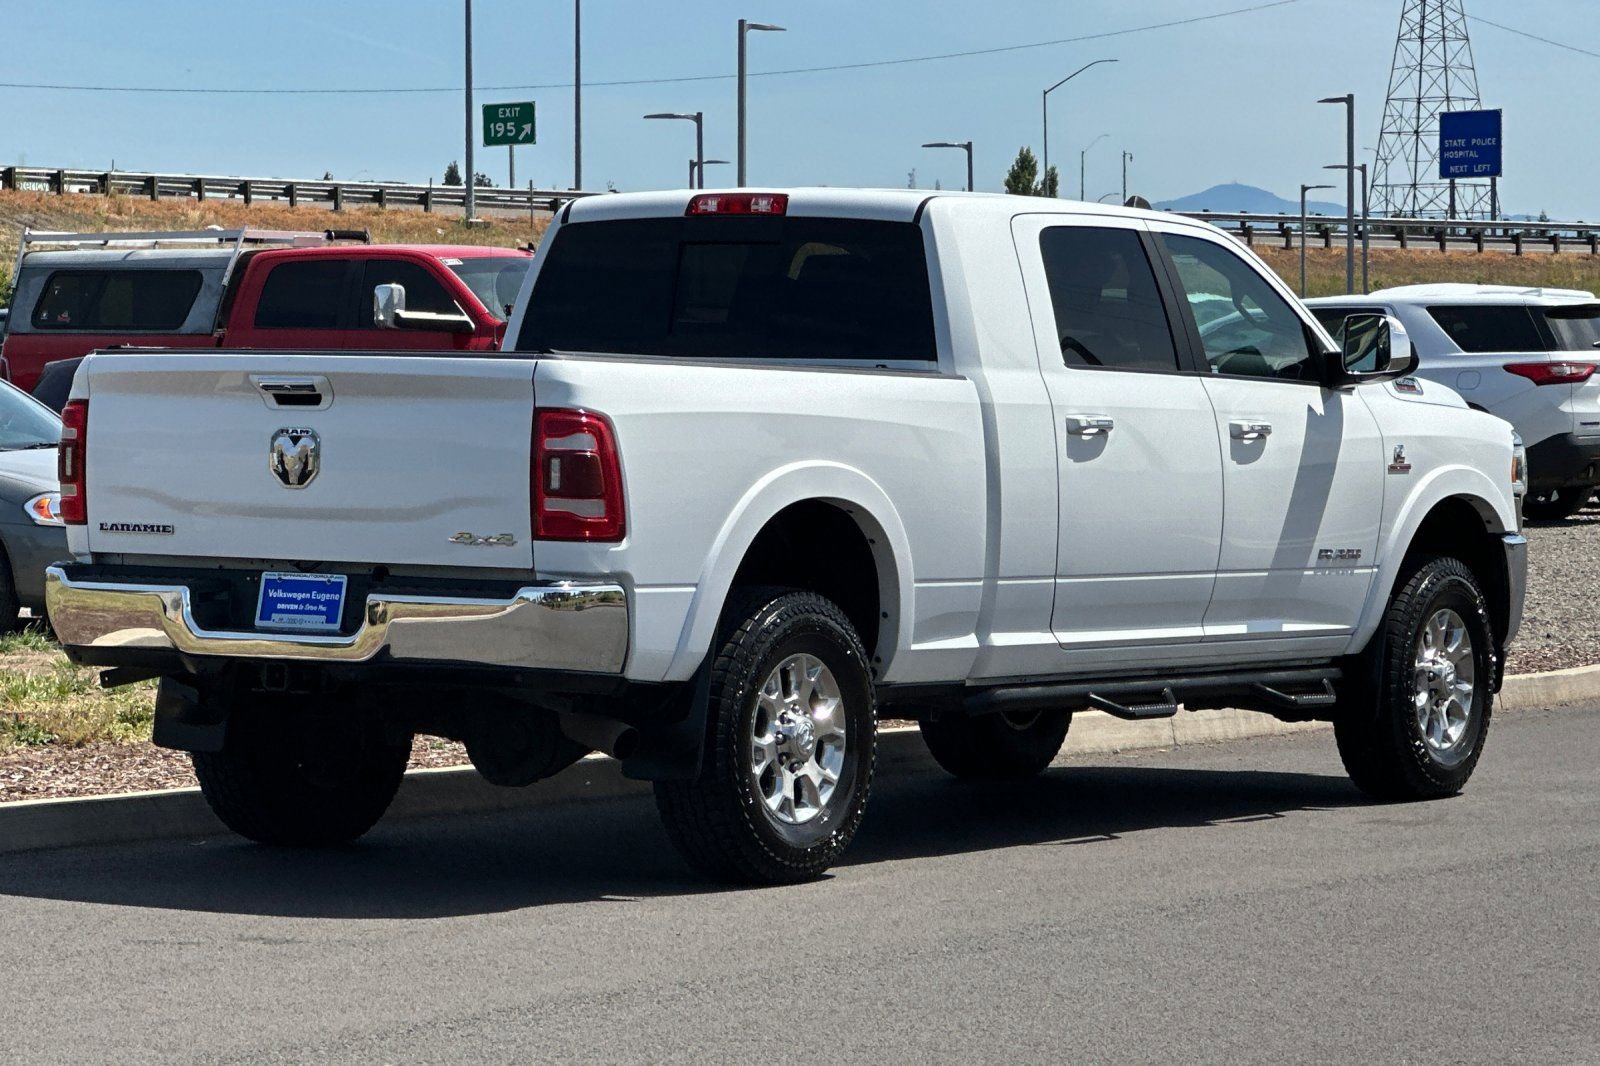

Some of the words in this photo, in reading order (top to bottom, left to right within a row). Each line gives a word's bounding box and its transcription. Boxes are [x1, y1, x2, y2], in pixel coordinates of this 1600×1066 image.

[498, 107, 521, 118] EXIT
[490, 122, 516, 138] 195
[1444, 139, 1466, 148] STATE
[1471, 137, 1497, 146] POLICE
[1443, 150, 1479, 159] HOSPITAL
[1449, 165, 1468, 173] NEXT
[1473, 164, 1491, 173] LEFT
[280, 428, 312, 436] RAM
[99, 522, 173, 534] LARAMIE
[1318, 548, 1362, 560] RAM
[268, 588, 311, 600] Volkswagen
[311, 590, 340, 602] Eugene
[276, 602, 299, 610] DRIVEN
